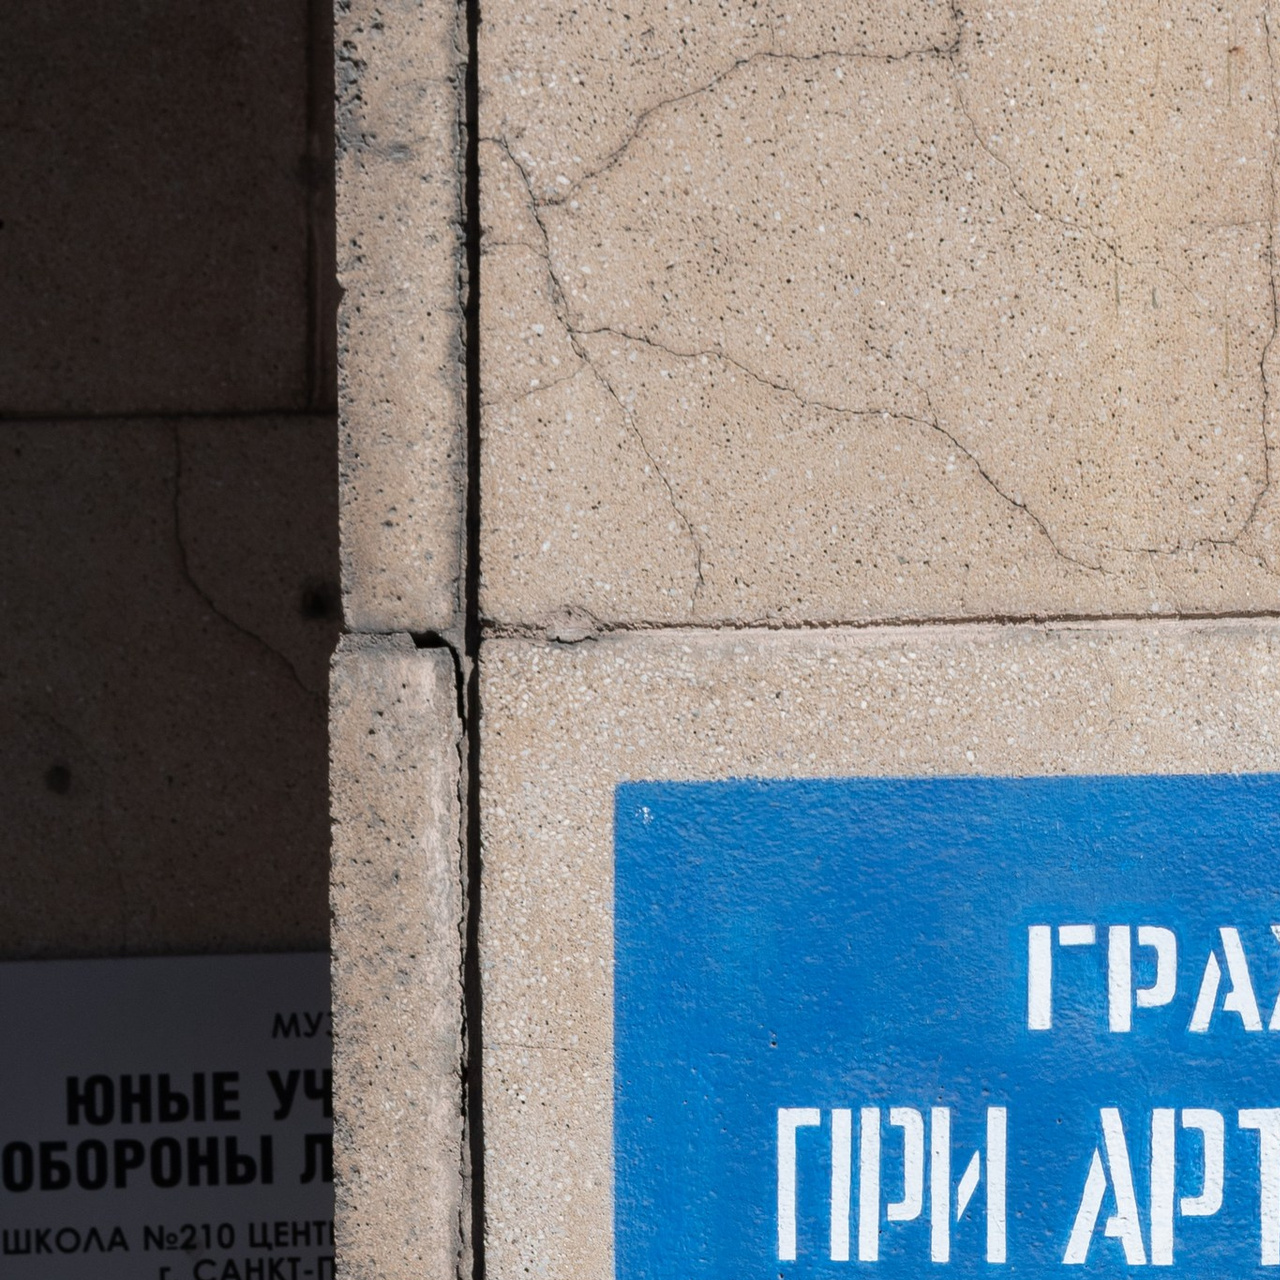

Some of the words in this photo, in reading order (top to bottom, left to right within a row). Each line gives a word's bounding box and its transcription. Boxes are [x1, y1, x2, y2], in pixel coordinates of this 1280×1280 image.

[66, 1071, 241, 1126] ЮНЫЕ
[2, 1135, 274, 1192] ОБОРОНЫ
[778, 1107, 1006, 1263] ПРИ
[3, 1226, 130, 1255] ШКОЛА
[143, 1222, 236, 1251] №210
